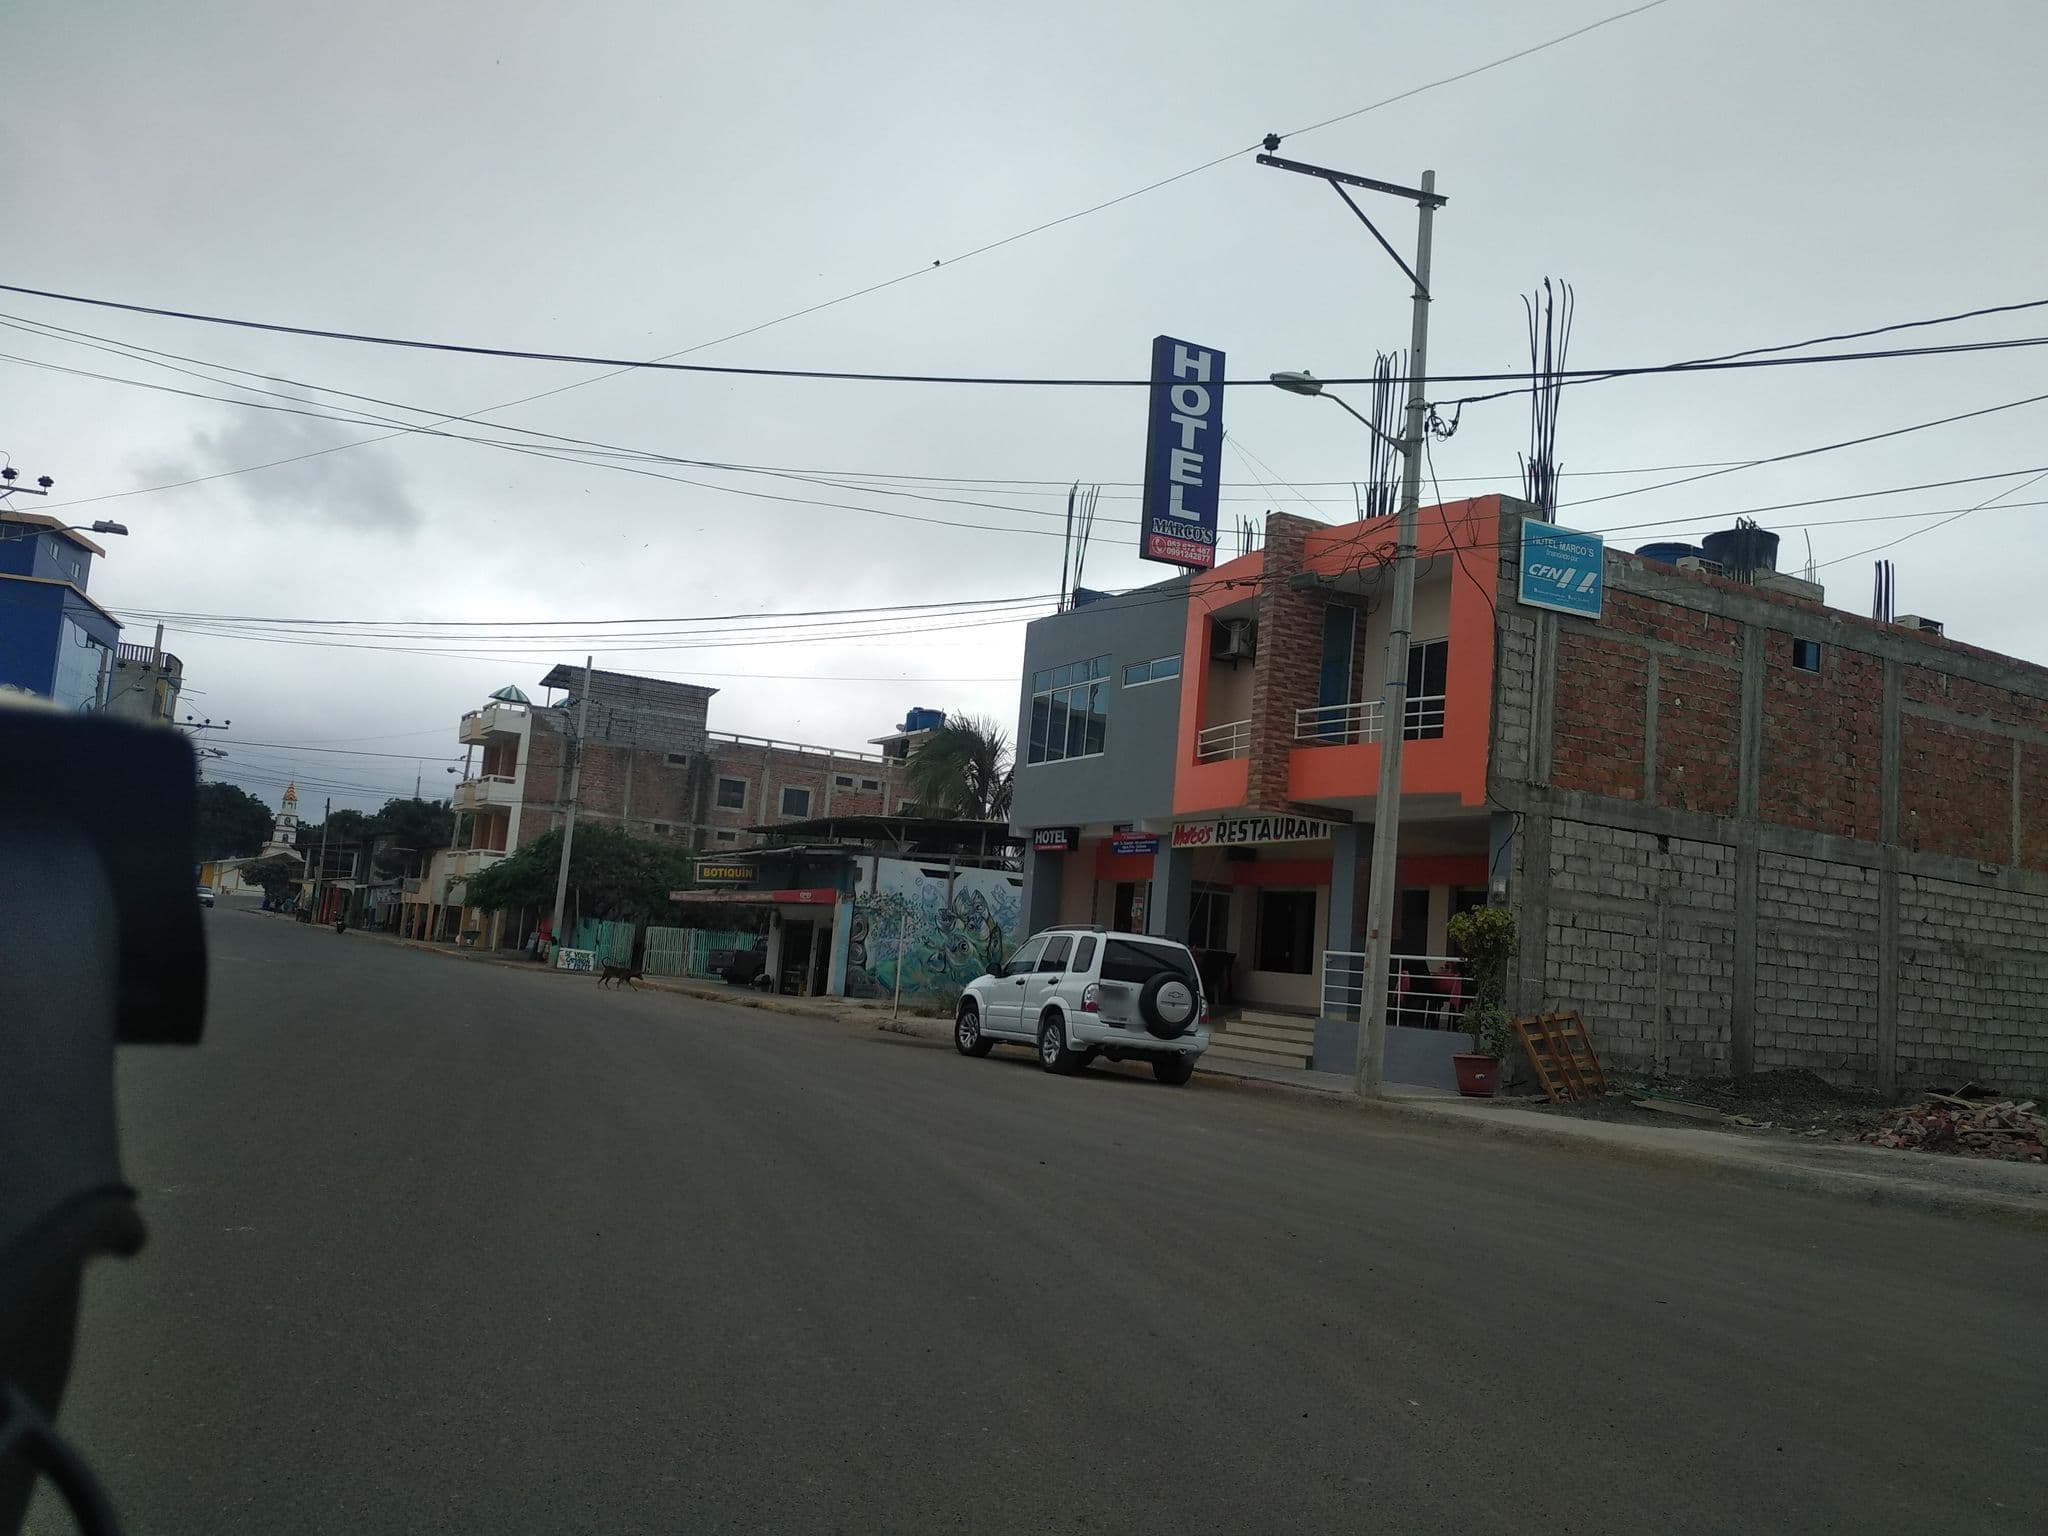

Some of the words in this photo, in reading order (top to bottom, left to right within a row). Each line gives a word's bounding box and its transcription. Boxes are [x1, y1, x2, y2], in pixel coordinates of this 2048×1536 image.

[1168, 344, 1213, 522] HOTEL
[1152, 517, 1213, 544] MARCO'S
[1532, 536, 1558, 550] HOTEL
[1559, 541, 1594, 558] MARCO'S
[1529, 564, 1562, 579] CFN
[1035, 829, 1068, 845] HOTEL
